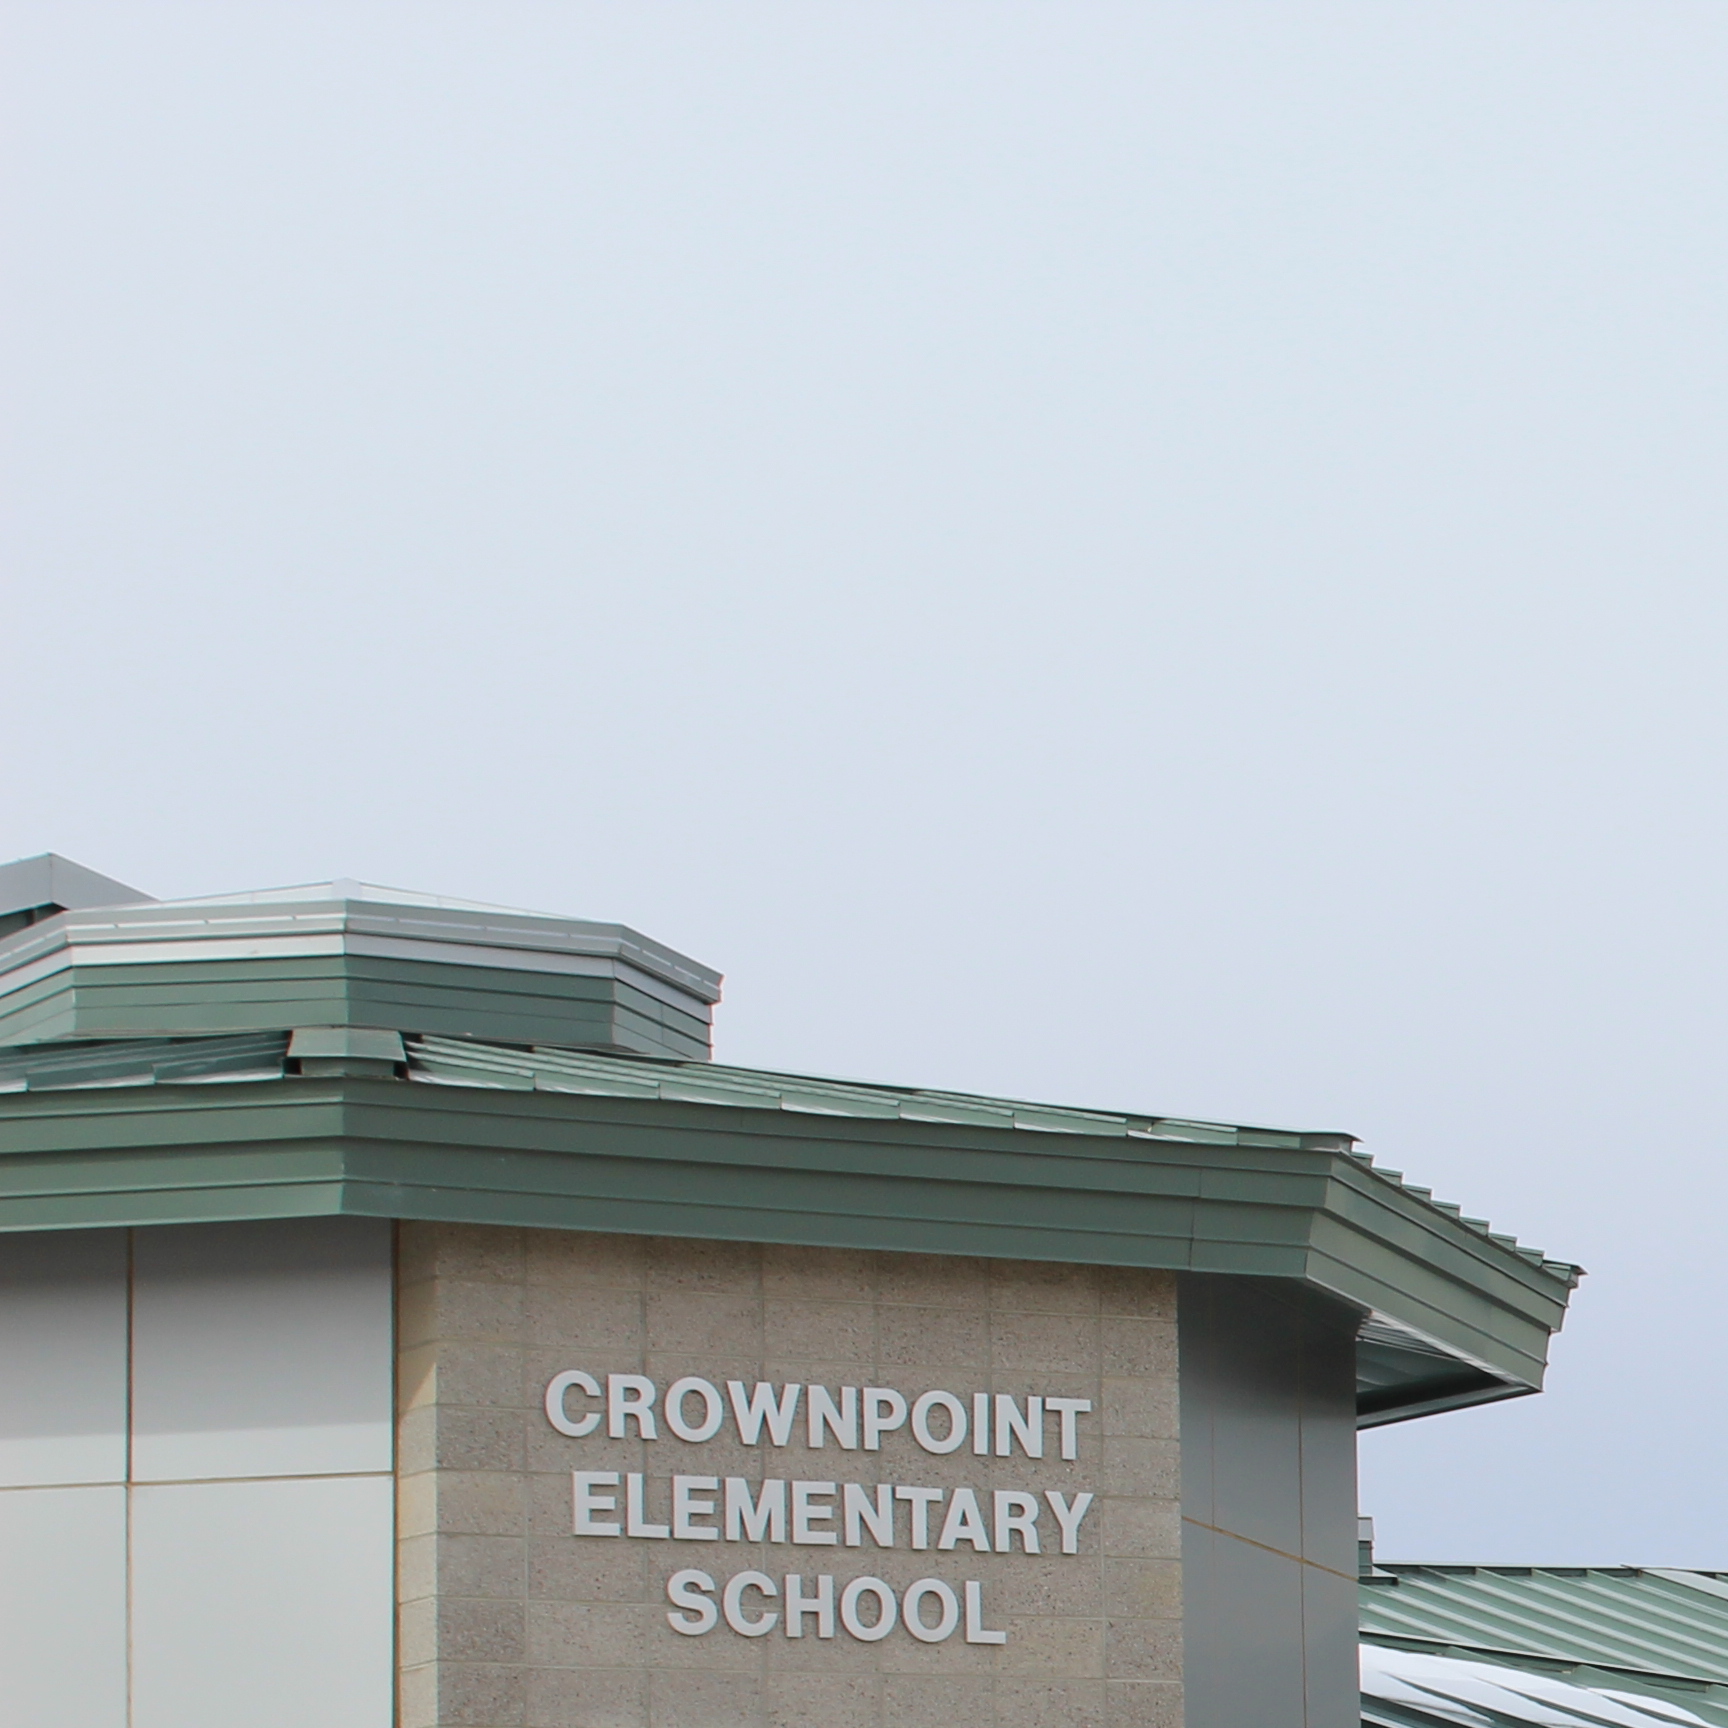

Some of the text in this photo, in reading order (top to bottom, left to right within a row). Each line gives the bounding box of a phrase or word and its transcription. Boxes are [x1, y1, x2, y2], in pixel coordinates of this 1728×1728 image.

[545, 1369, 1092, 1461] CROWNPOINT
[572, 1470, 1094, 1554] ELEMENTARY
[666, 1568, 1007, 1645] SCHOOL
